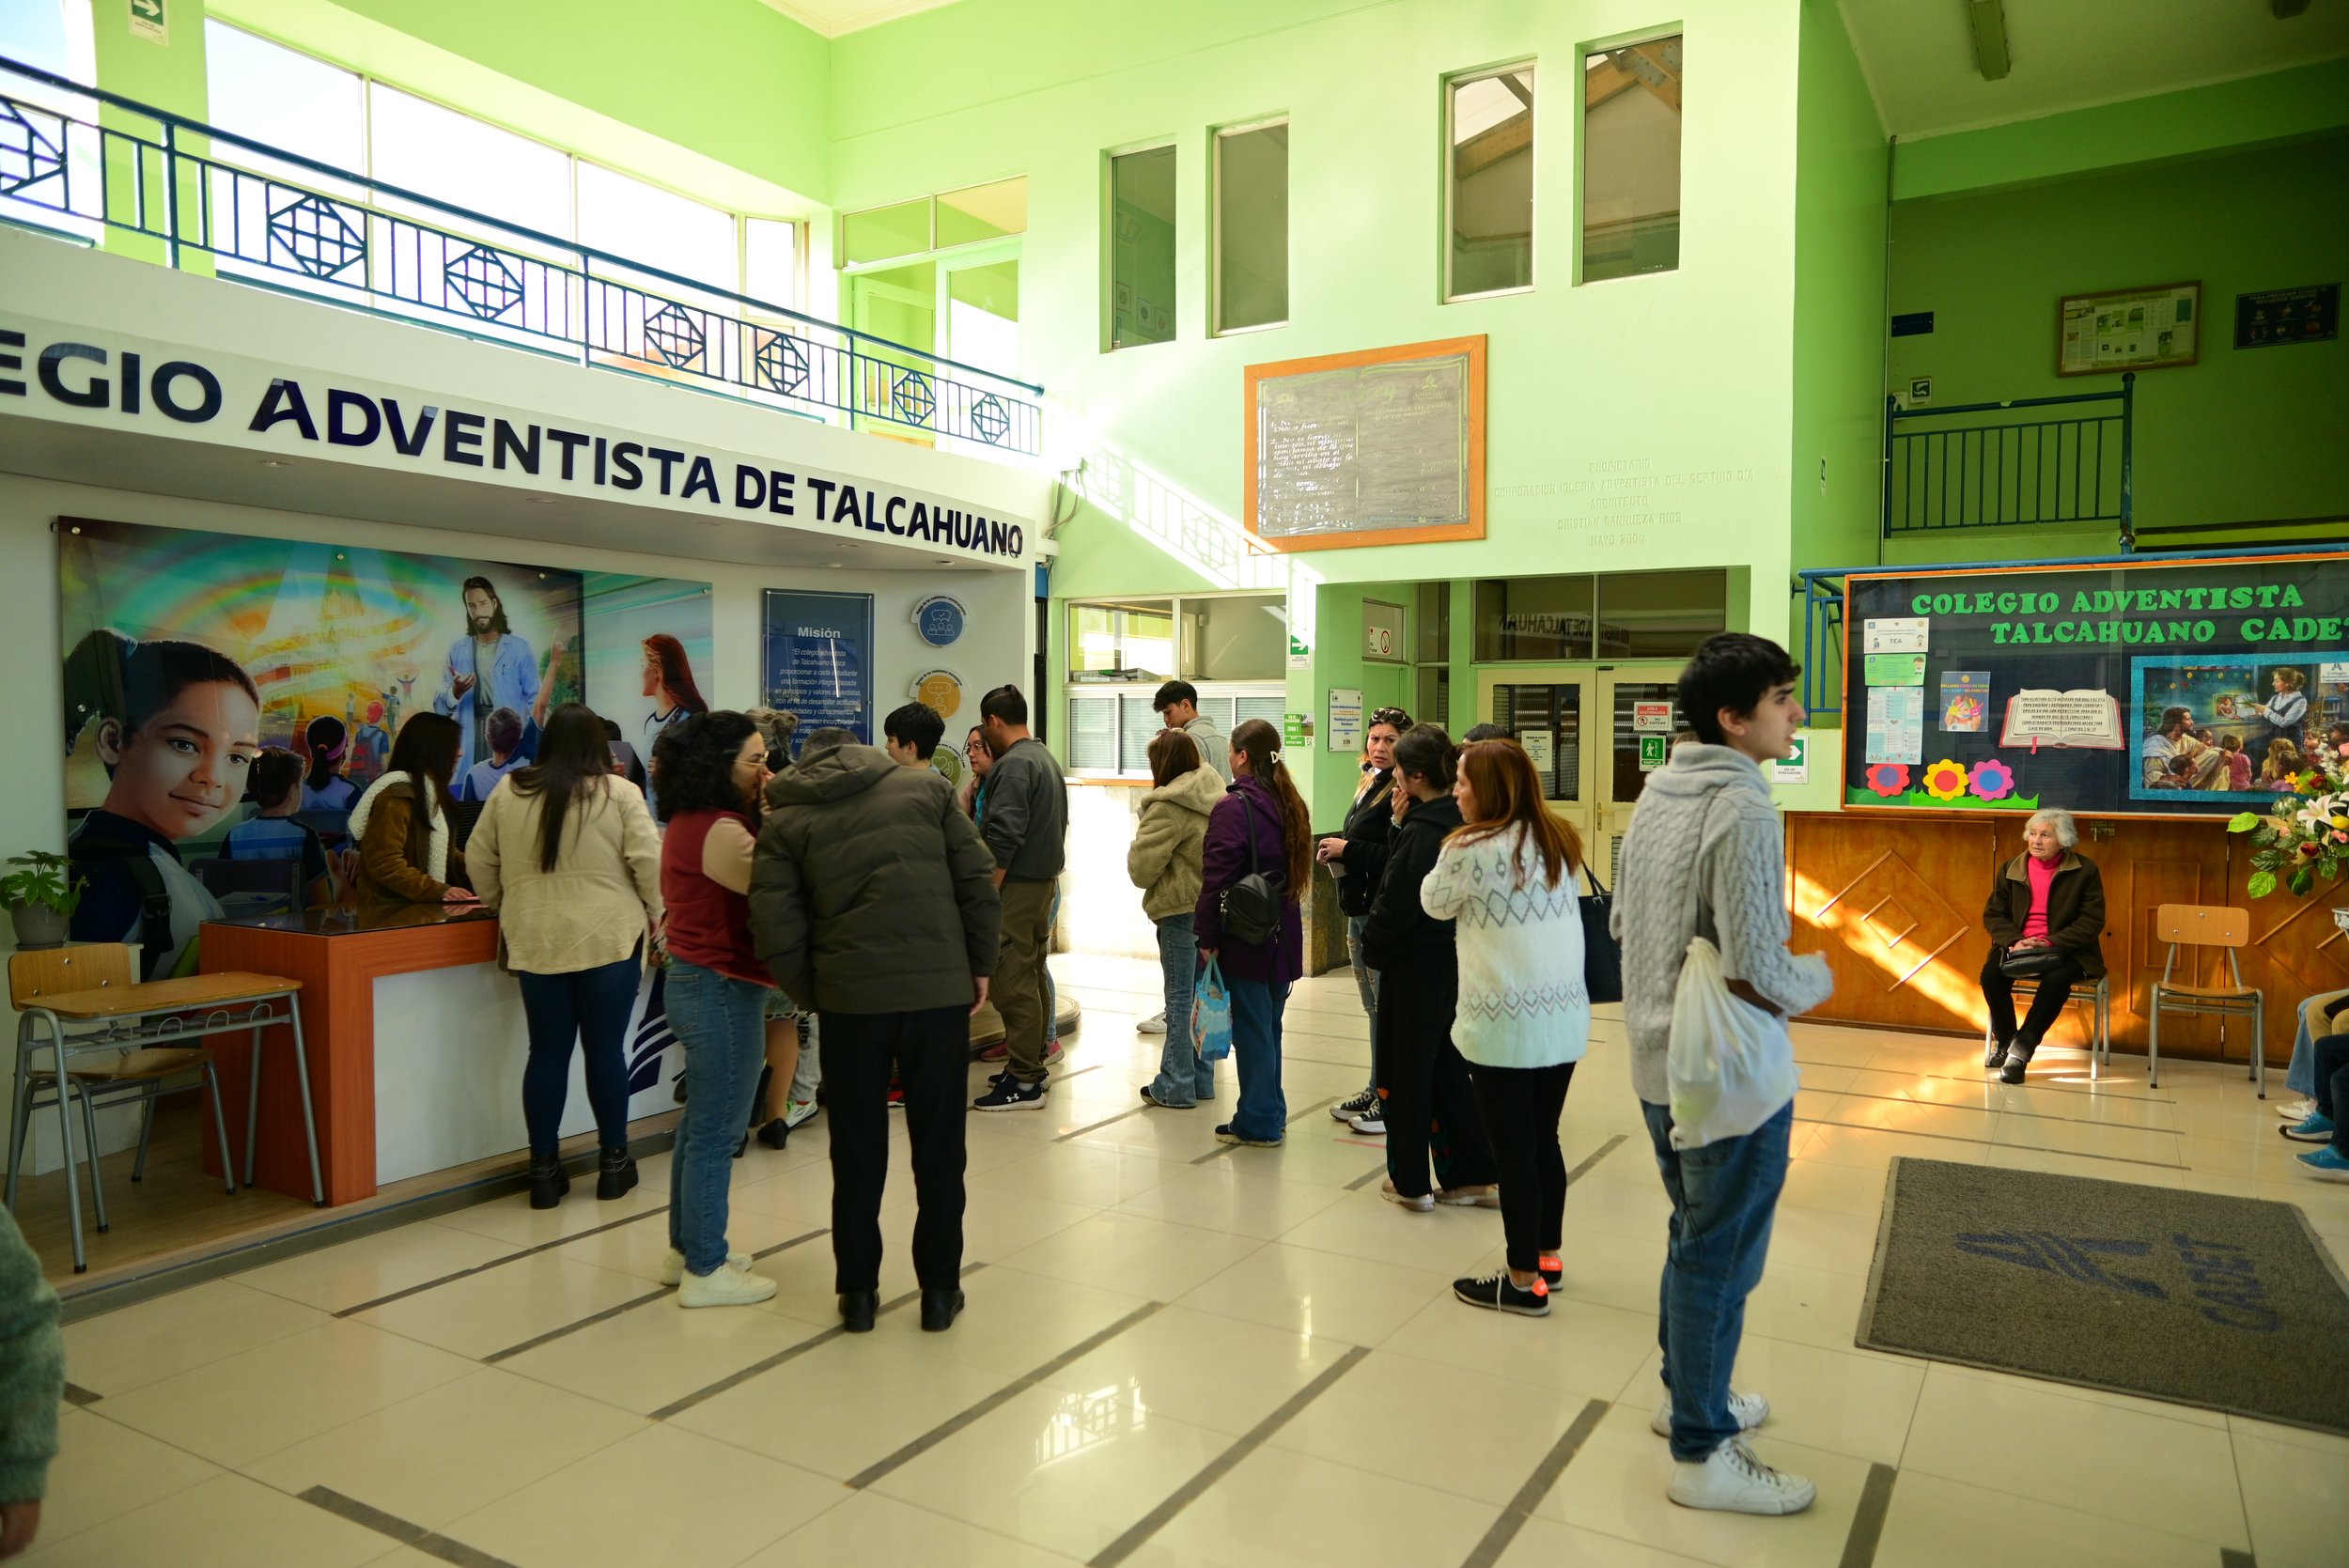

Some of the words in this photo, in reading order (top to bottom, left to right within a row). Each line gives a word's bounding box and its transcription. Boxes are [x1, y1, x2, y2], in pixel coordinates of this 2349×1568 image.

[248, 378, 721, 505] ADVENTISTA
[736, 464, 795, 516] DE
[807, 479, 1023, 559] TALCAHUANO
[1589, 458, 1651, 474] PROPIETARIO
[1560, 480, 1595, 493] IGLESIA
[1600, 475, 1660, 490] ADVENTISTA
[1665, 474, 1685, 487] DEL
[1590, 495, 1649, 509] ARQUITECTO
[1558, 516, 1600, 530] CRISTIAN
[1604, 513, 1655, 527] SANHUEZA
[1591, 534, 1615, 547] MAYO
[1911, 592, 2060, 614] COLEGIO
[2071, 583, 2304, 613] ADVENTISTA
[798, 627, 841, 639] Misión
[1990, 620, 2216, 644] TALCAHUANO
